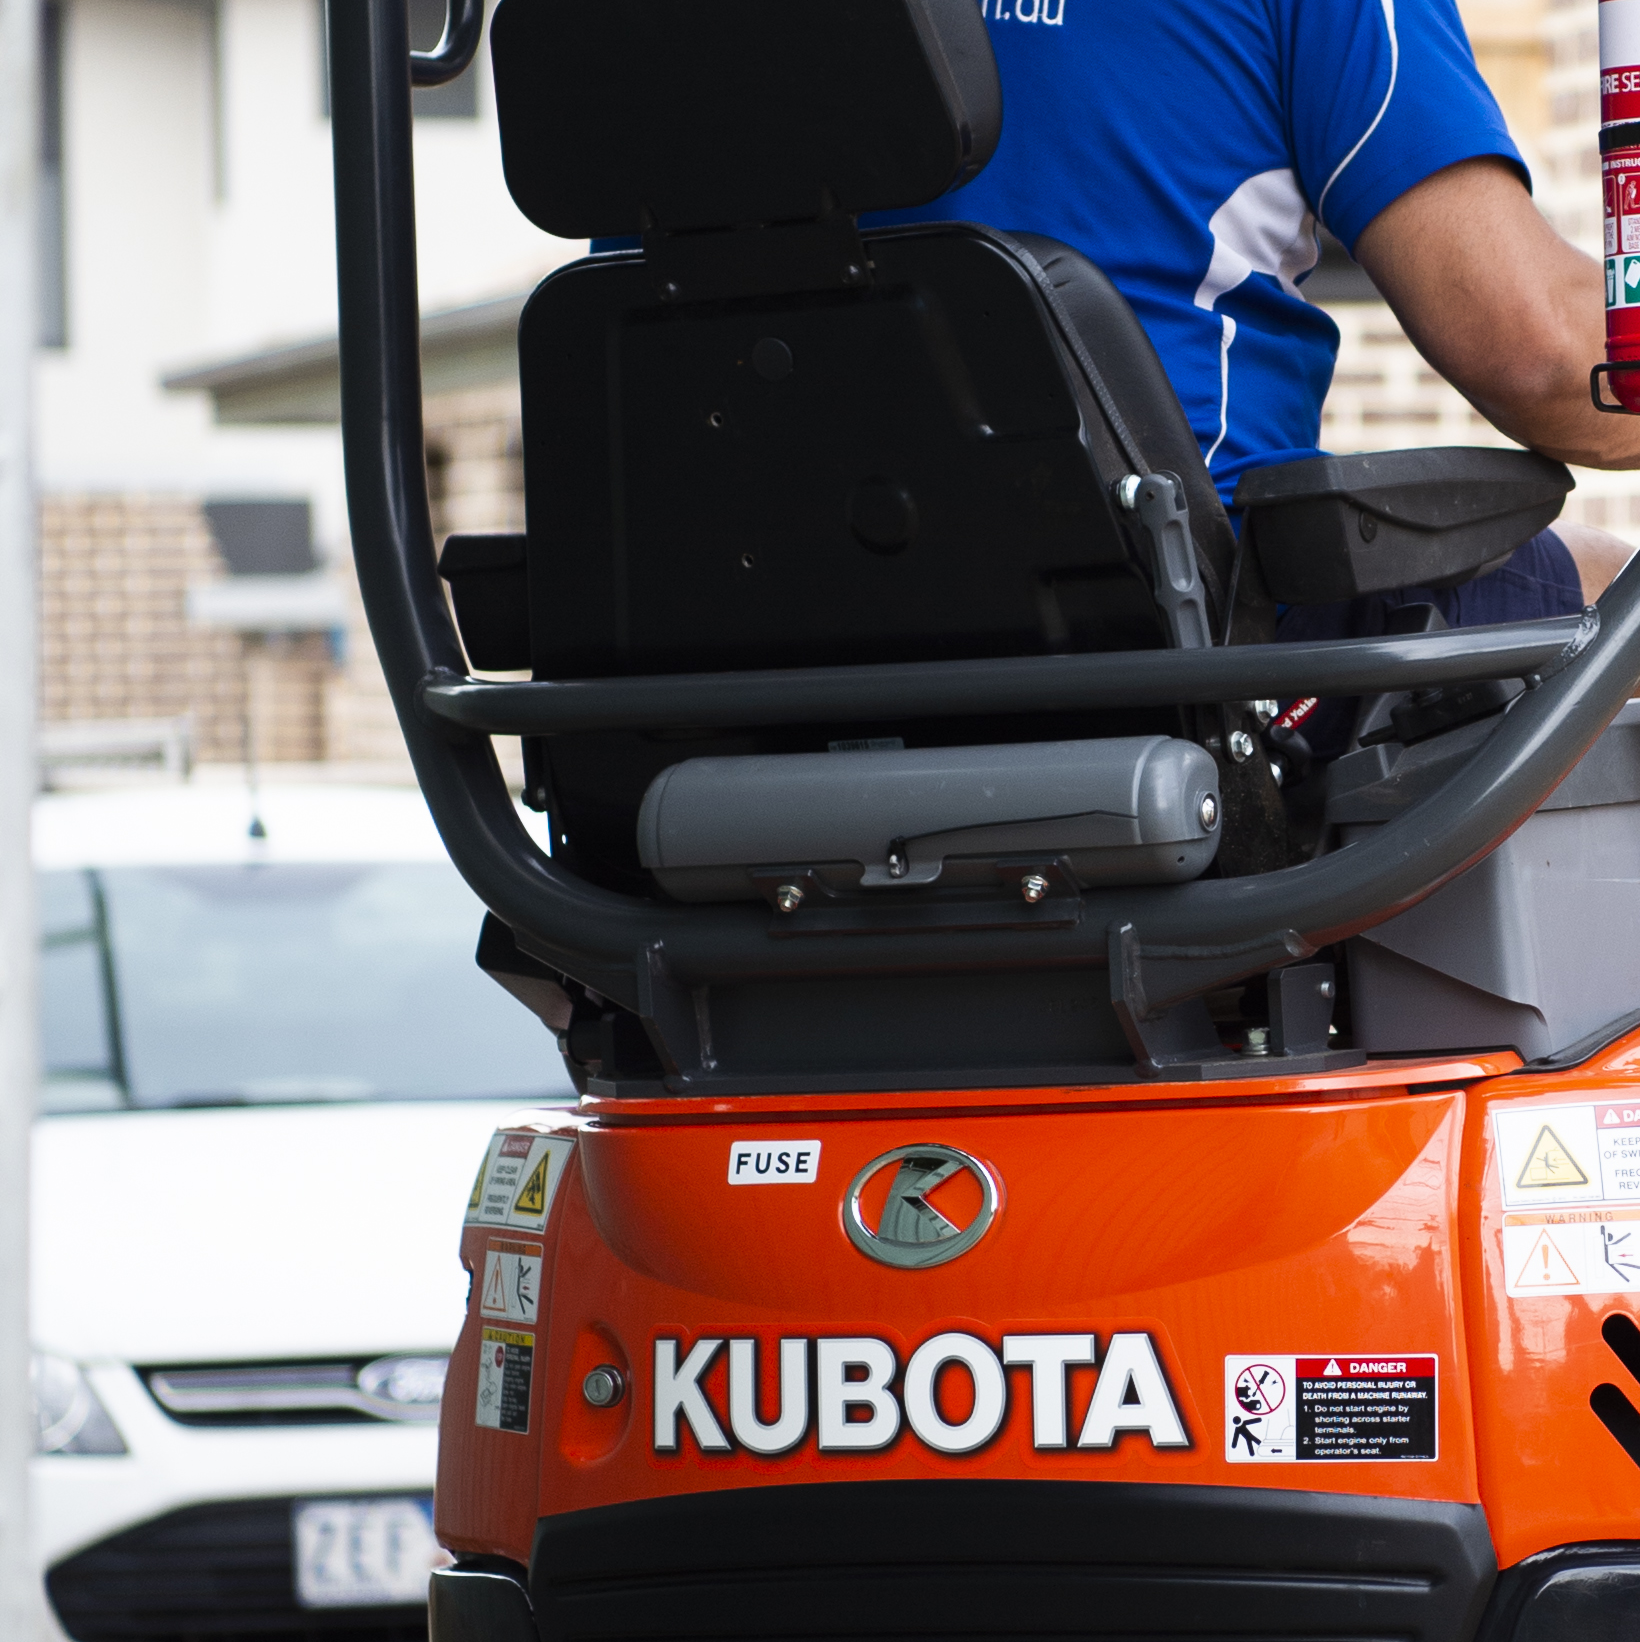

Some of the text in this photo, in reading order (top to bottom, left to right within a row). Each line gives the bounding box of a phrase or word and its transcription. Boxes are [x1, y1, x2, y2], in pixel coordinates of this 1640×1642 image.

[1603, 1149, 1618, 1160] OF
[735, 1151, 812, 1175] FUSE
[1544, 1211, 1614, 1225] WARNING
[1349, 1362, 1407, 1374] DANGER
[1303, 1380, 1417, 1389] TO AVOID PERSONAL INJURY OR
[653, 1330, 1190, 1453] KUBOTA
[1302, 1392, 1326, 1400] DEATH
[1328, 1392, 1350, 1400] FROM
[1357, 1391, 1390, 1400] MACHINE
[1314, 1405, 1328, 1413] Do
[1329, 1405, 1344, 1413] not
[1345, 1405, 1365, 1413] start
[1366, 1405, 1396, 1414] engine
[1398, 1404, 1410, 1414] by
[1314, 1416, 1350, 1425] shorting
[1382, 1415, 1411, 1423] starter
[1314, 1437, 1336, 1445] Start
[1337, 1437, 1367, 1446] engine
[1368, 1436, 1387, 1446] only
[1389, 1436, 1410, 1444] from
[1314, 1447, 1359, 1456] operator's
